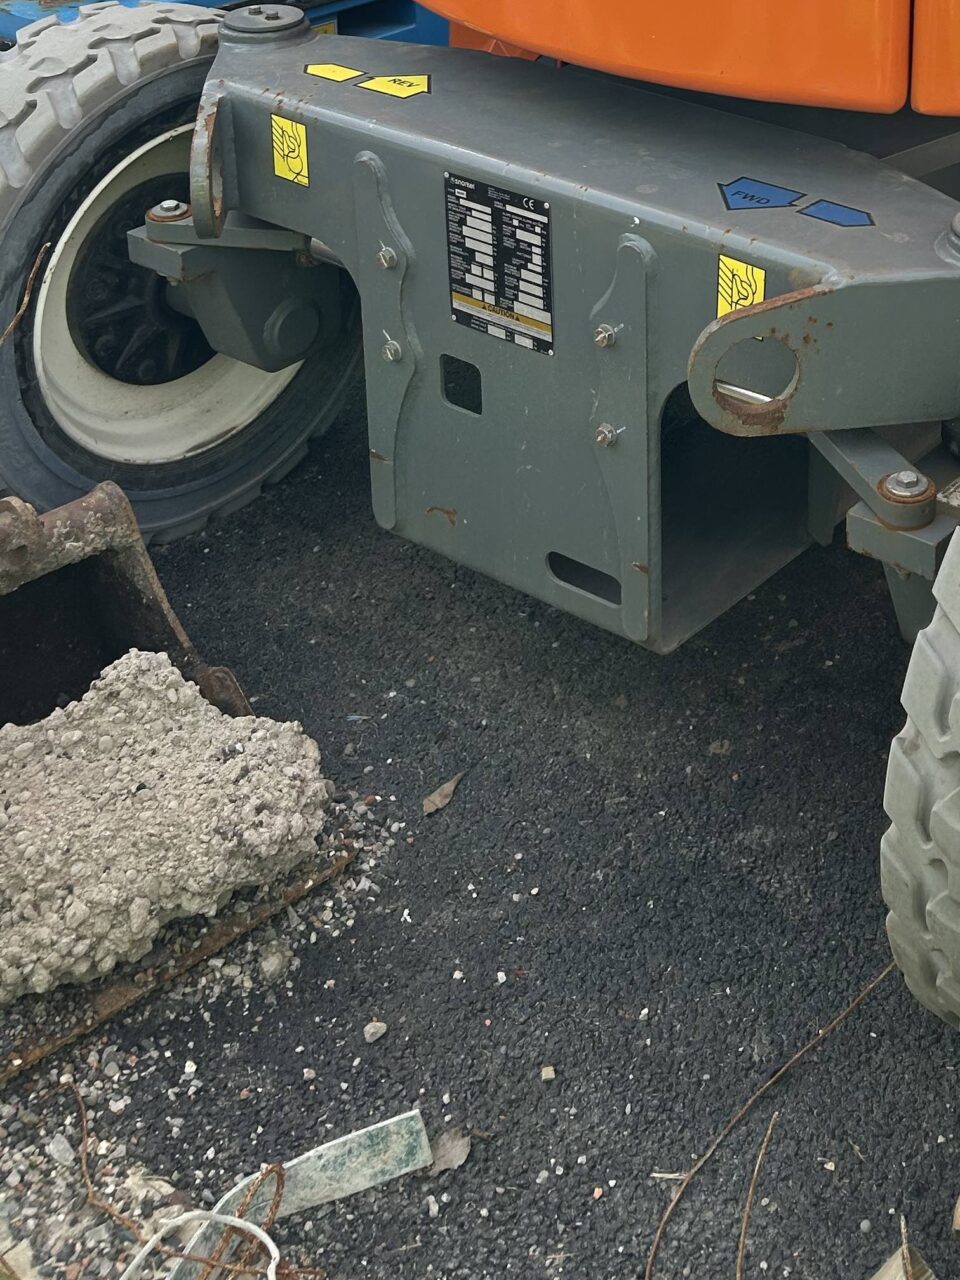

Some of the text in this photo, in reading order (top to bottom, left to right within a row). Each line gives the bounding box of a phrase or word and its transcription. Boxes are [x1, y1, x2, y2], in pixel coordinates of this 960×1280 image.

[387, 77, 421, 88] REV
[731, 190, 772, 205] FWD
[487, 305, 515, 320] CAUTION
